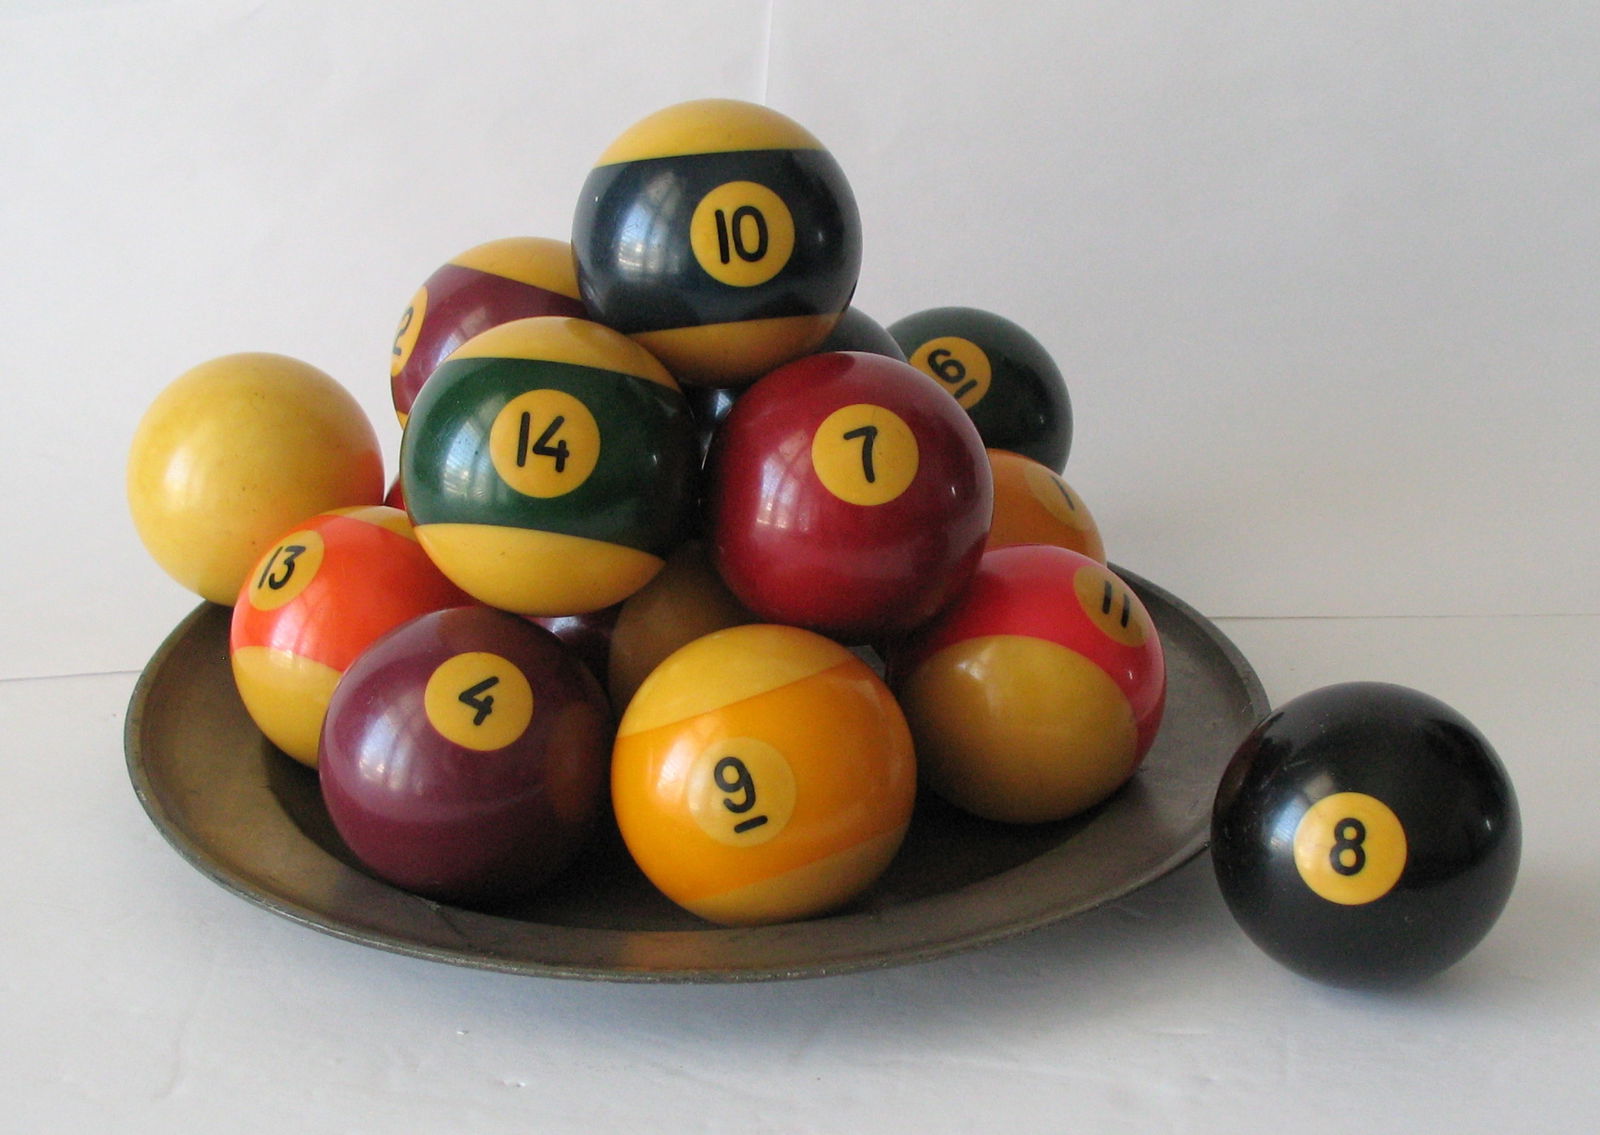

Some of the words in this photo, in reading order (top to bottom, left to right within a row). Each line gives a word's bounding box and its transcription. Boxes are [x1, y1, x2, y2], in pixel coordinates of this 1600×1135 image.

[714, 205, 769, 265] 10
[926, 349, 966, 385] 6
[516, 411, 570, 473] 14
[843, 425, 878, 484] 7
[257, 544, 305, 590] 13
[1100, 579, 1129, 629] 11
[456, 676, 499, 726] 4
[713, 756, 757, 815] 9
[1329, 817, 1366, 876] 8
